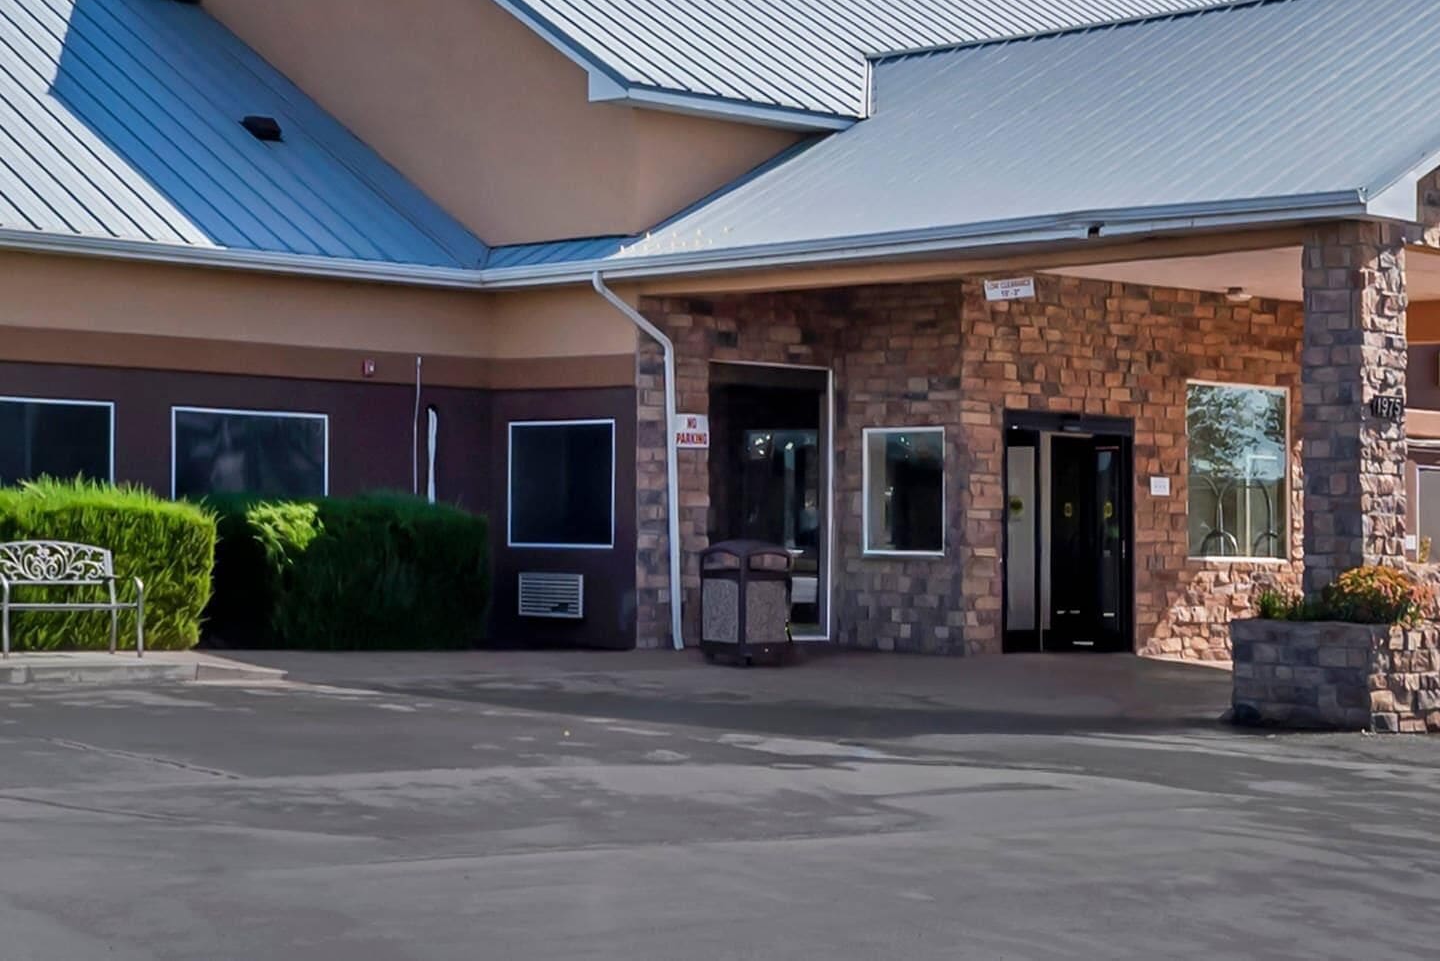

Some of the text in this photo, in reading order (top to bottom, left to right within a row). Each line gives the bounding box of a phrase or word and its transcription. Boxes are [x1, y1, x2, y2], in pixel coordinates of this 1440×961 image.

[1377, 397, 1401, 417] 1975
[687, 417, 697, 429] NO
[676, 432, 707, 445] PARKING
